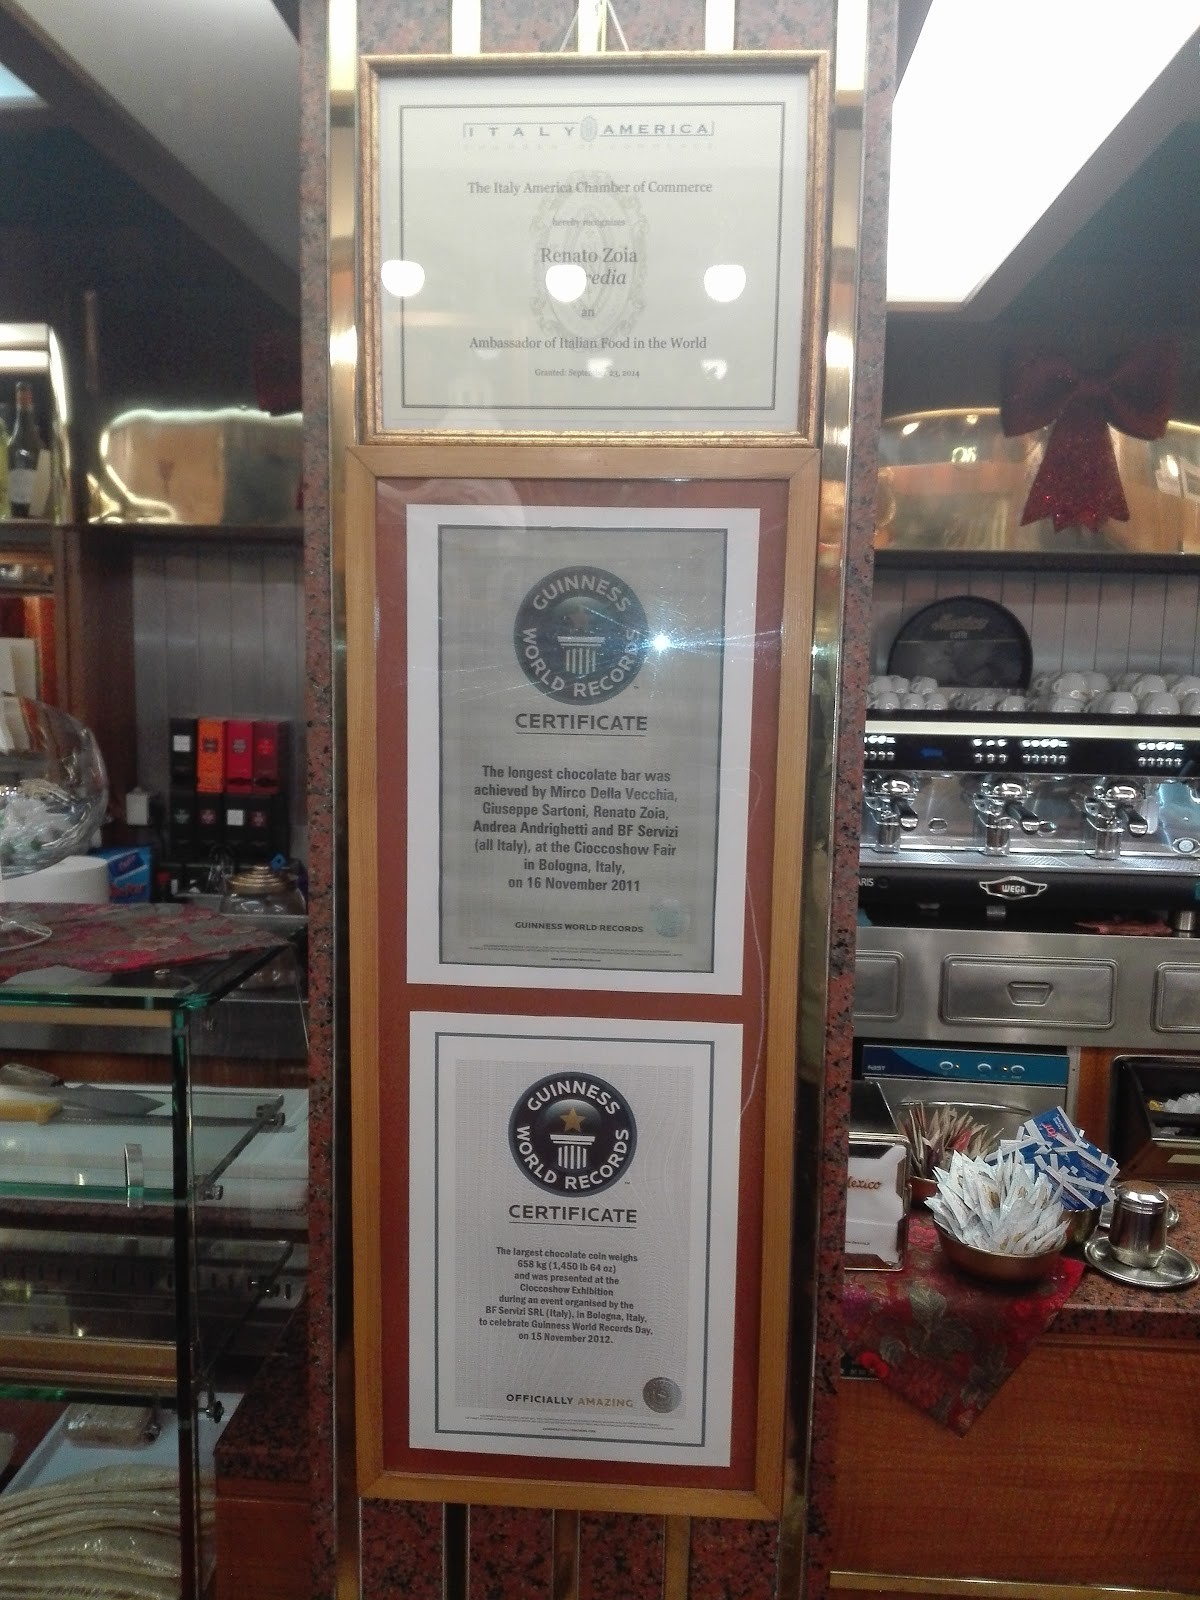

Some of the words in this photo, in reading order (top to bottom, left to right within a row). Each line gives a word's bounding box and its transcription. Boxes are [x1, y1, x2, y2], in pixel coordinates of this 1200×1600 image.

[468, 127, 575, 137] ITALY
[603, 124, 709, 135] AMERICA
[468, 182, 490, 194] The
[493, 182, 520, 195] Italy
[522, 182, 573, 194] America
[575, 181, 630, 194] Chamber
[633, 181, 646, 193] of
[648, 182, 713, 193] Commerce
[540, 247, 598, 263] Renato
[602, 247, 638, 263] Zoia
[581, 308, 595, 317] an
[469, 337, 541, 349] Ambassador
[544, 337, 557, 349] of
[559, 337, 597, 349] Italian
[600, 337, 630, 349] Food
[633, 337, 645, 349] in
[648, 337, 667, 349] the
[670, 337, 707, 349] World
[534, 369, 566, 377] Granted:
[622, 370, 640, 378] 2014
[533, 574, 632, 612] GUINNESS
[522, 627, 565, 691] WORLD
[573, 628, 640, 697] RECORDS
[515, 713, 648, 731] CERTIFICATE
[482, 765, 504, 778] The
[508, 766, 553, 781] longest
[556, 767, 617, 781] chocolate
[620, 768, 641, 782] bar
[645, 771, 671, 782] was
[474, 784, 528, 797] achieved
[532, 785, 547, 800] by
[550, 785, 586, 799] Mirco
[590, 786, 621, 800] Della
[625, 787, 678, 803] Vecchia,
[482, 802, 538, 818] Giuseppe
[542, 803, 589, 818] Sartoni,
[593, 805, 636, 819] Renato
[640, 806, 669, 821] Zoia,
[473, 820, 516, 834] Andrea
[520, 821, 588, 837] Andrighetti
[591, 824, 614, 836] and
[617, 824, 634, 836] BF
[637, 825, 679, 838] Servizi
[474, 838, 493, 853] (all
[497, 839, 531, 855] Italy),
[535, 842, 548, 853] at
[551, 841, 570, 853] the
[574, 841, 649, 856] Cioccoshow
[653, 843, 676, 856] Fair
[524, 859, 535, 871] in
[539, 859, 591, 874] Bologna,
[596, 860, 625, 876] Italy,
[508, 879, 523, 889] on
[527, 877, 541, 889] 16
[545, 877, 608, 891] November
[611, 880, 640, 892] 2011
[1001, 884, 1026, 893] WEGA
[514, 921, 563, 930] GUINNESS
[564, 923, 598, 932] WORLD
[600, 924, 644, 933] RECORDS
[527, 1080, 621, 1115] GUINNESS
[516, 1125, 557, 1184] WORLD
[565, 1129, 630, 1190] RECORDS
[847, 1176, 881, 1190] exico
[508, 1204, 638, 1224] CERTIFICATE
[496, 1246, 511, 1256] The
[513, 1247, 543, 1258] largest
[545, 1249, 586, 1260] chocolate
[589, 1252, 606, 1260] coin
[608, 1252, 638, 1264] weighs
[517, 1260, 534, 1268] 658
[536, 1260, 547, 1271] kg
[580, 1262, 588, 1271] lb
[603, 1264, 617, 1274] oz)
[514, 1272, 530, 1281] and
[532, 1273, 548, 1281] was
[550, 1273, 593, 1284] presented
[594, 1276, 604, 1284] at
[605, 1276, 620, 1285] the
[520, 1283, 570, 1294] Cioccoshow
[572, 1286, 614, 1296] Exhibition
[498, 1294, 526, 1305] during
[528, 1297, 539, 1305] an
[540, 1297, 563, 1305] event
[565, 1298, 607, 1310] organised
[608, 1300, 618, 1310] by
[620, 1301, 634, 1310] the
[485, 1306, 497, 1314] BF
[498, 1306, 526, 1315] Servizi
[527, 1307, 544, 1317] SRL
[576, 1310, 585, 1319] in
[479, 1318, 488, 1326] to
[489, 1318, 529, 1328] celebrate
[531, 1320, 570, 1330] Guinness
[572, 1322, 597, 1331] World
[600, 1323, 633, 1333] Records
[518, 1332, 529, 1340] on
[531, 1332, 542, 1341] 15
[544, 1333, 586, 1343] November
[587, 1335, 614, 1344] 2012.
[506, 1393, 574, 1405] OFFICIALLY
[577, 1397, 633, 1408] AMAZING
